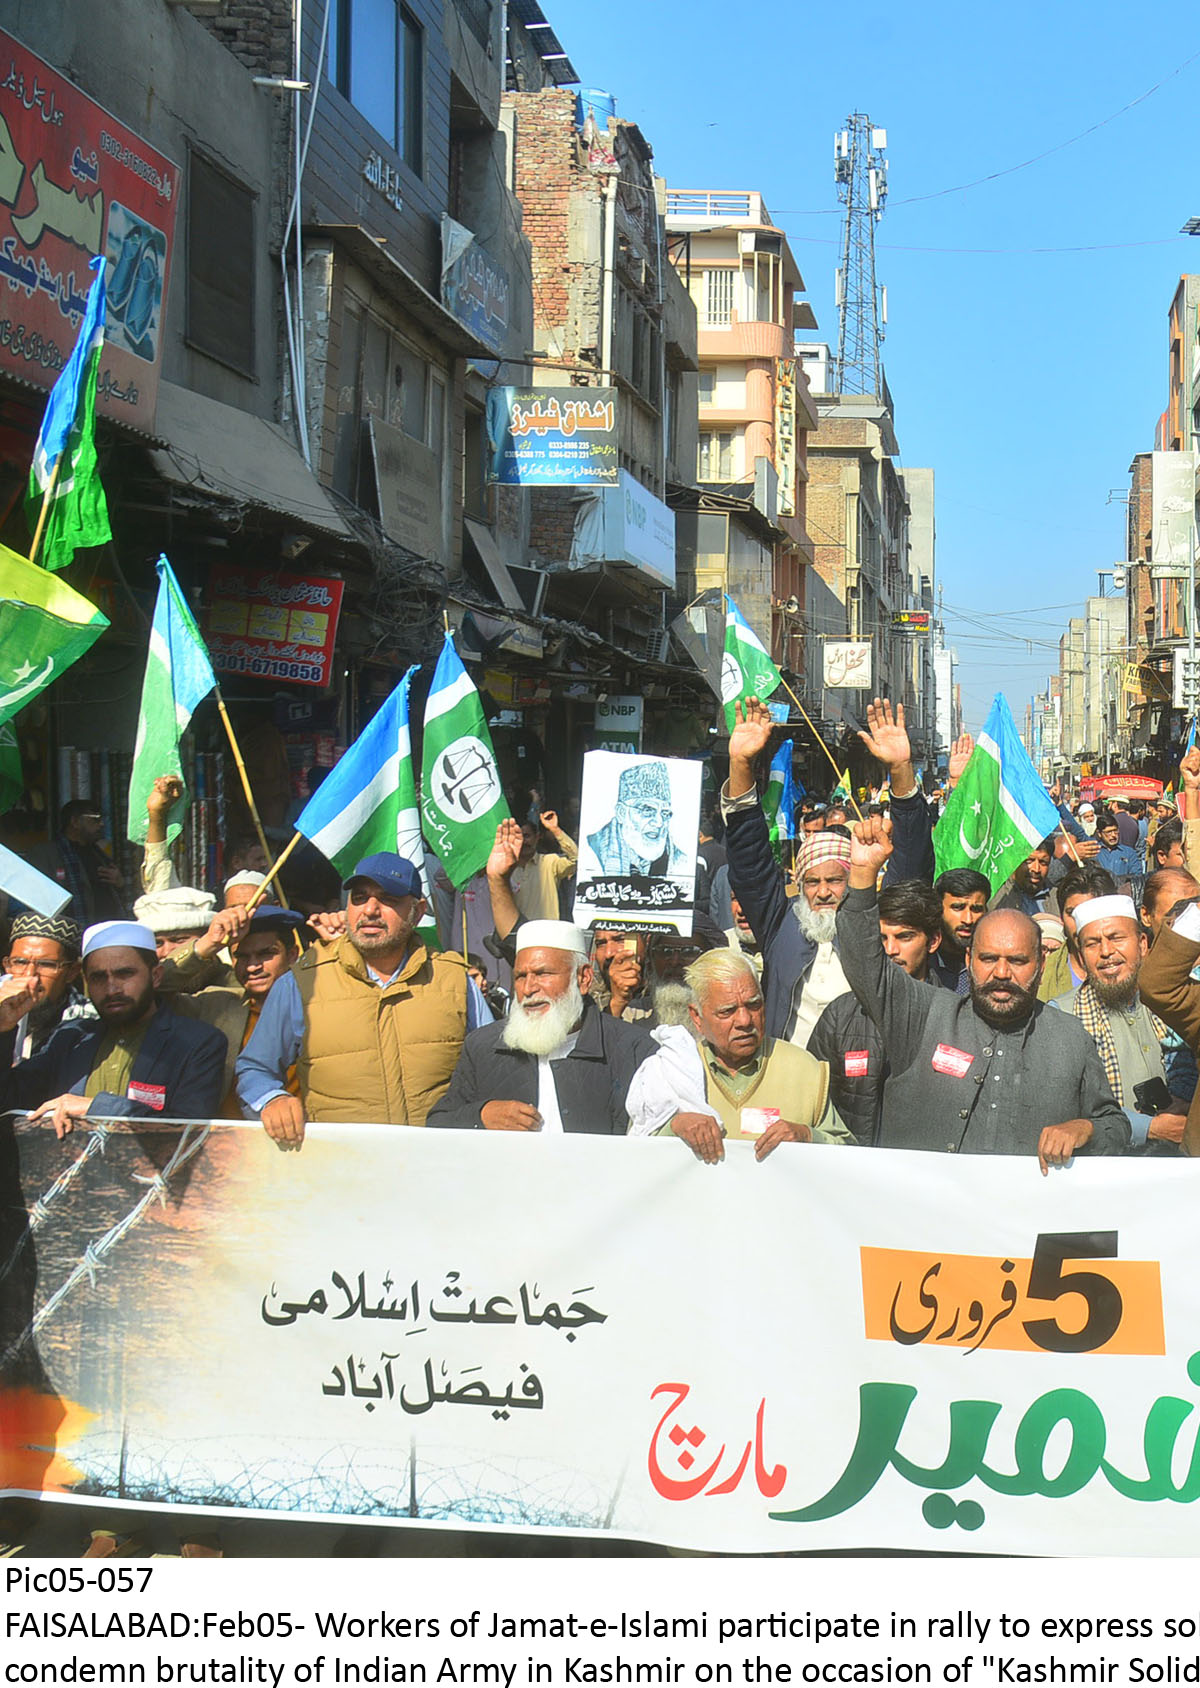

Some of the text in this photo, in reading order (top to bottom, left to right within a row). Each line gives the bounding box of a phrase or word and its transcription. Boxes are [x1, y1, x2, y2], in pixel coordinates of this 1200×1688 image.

[70, 146, 100, 185] نیو
[508, 396, 615, 437] اشفاق ٹیلرز
[778, 358, 796, 515] MEHFIL
[610, 704, 636, 717] NBP
[600, 741, 634, 754] ATM
[586, 881, 620, 905] پاکستان
[889, 1229, 1124, 1357] 5 فروری
[647, 1381, 788, 1502] مارچ
